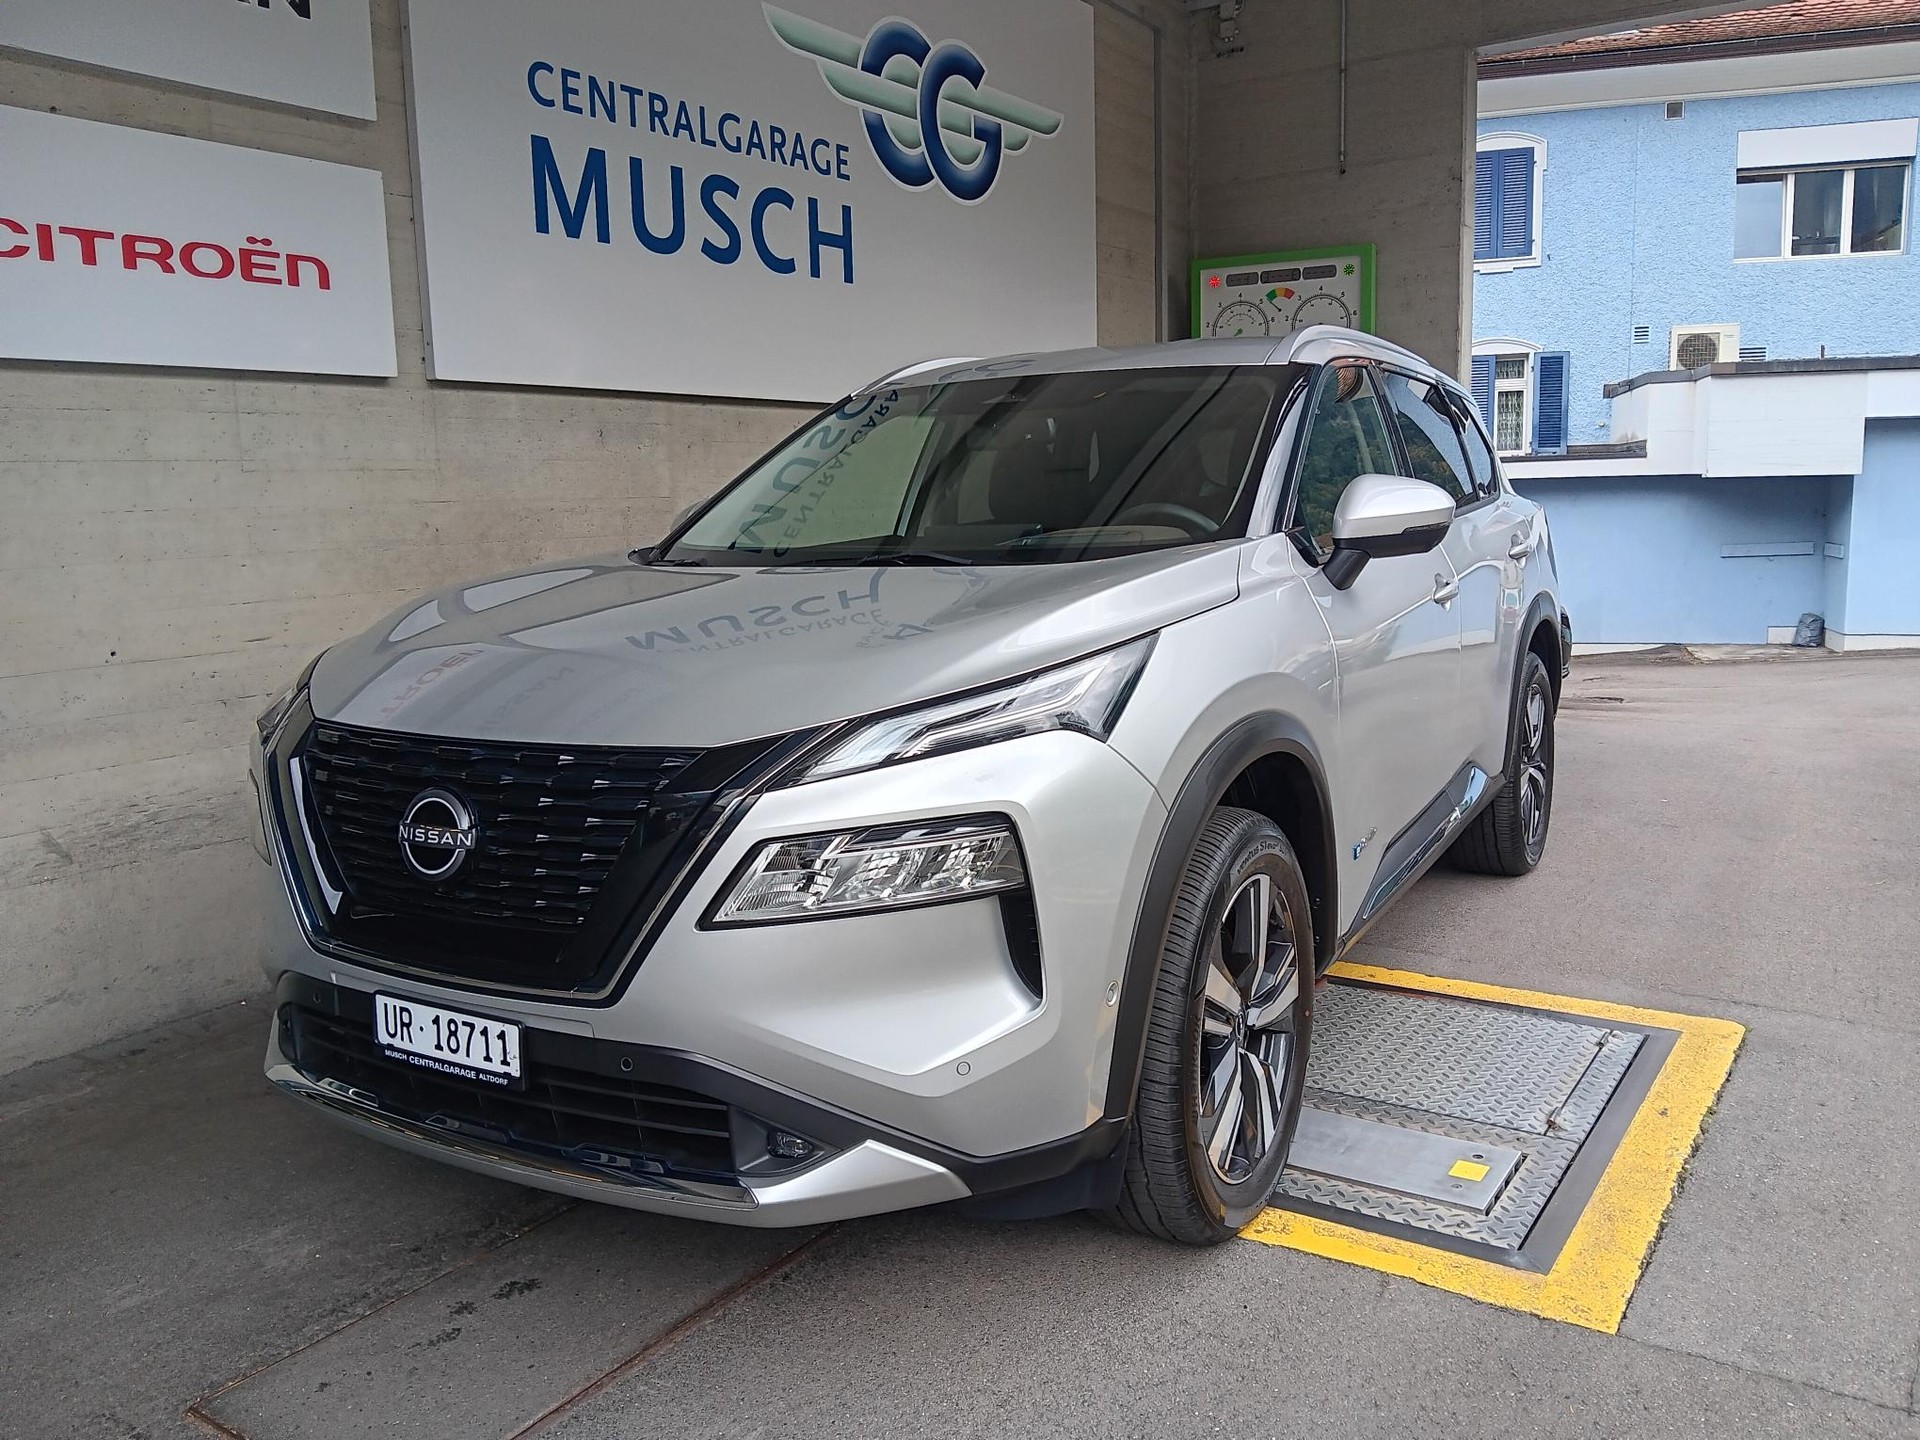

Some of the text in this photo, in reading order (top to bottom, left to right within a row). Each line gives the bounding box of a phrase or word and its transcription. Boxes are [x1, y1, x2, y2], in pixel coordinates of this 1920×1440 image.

[526, 60, 851, 181] CENTRALGARAGE
[530, 133, 855, 285] MUSCH
[398, 824, 473, 846] NISSAN
[384, 1048, 509, 1086] MUSCH CENTRALGARAGE ALTDORF
